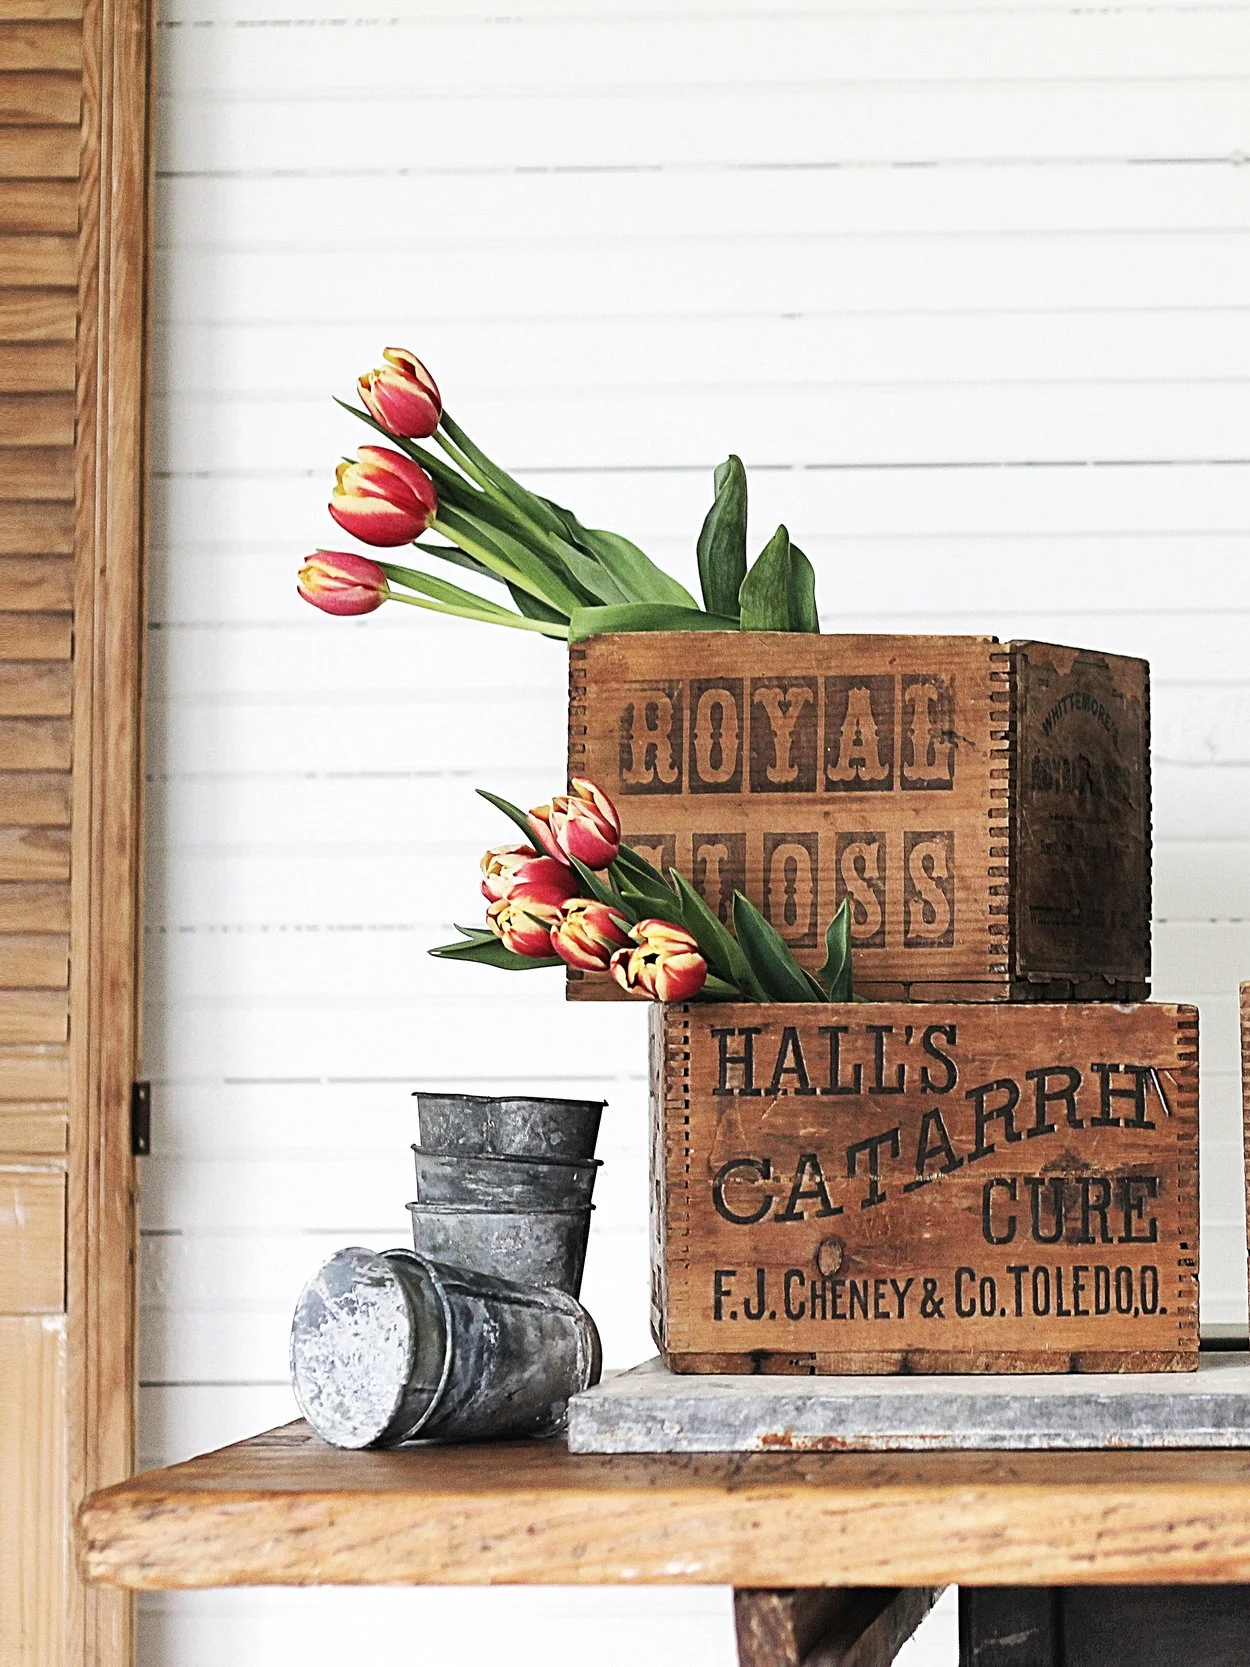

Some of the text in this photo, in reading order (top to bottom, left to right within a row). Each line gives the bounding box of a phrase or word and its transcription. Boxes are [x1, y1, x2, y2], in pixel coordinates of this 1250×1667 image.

[619, 675, 955, 793] ROYAL
[711, 1024, 958, 1098] HALL'S
[712, 1062, 1158, 1226] CATARRH
[981, 1175, 1159, 1245] CURE
[920, 1277, 945, 1319] &
